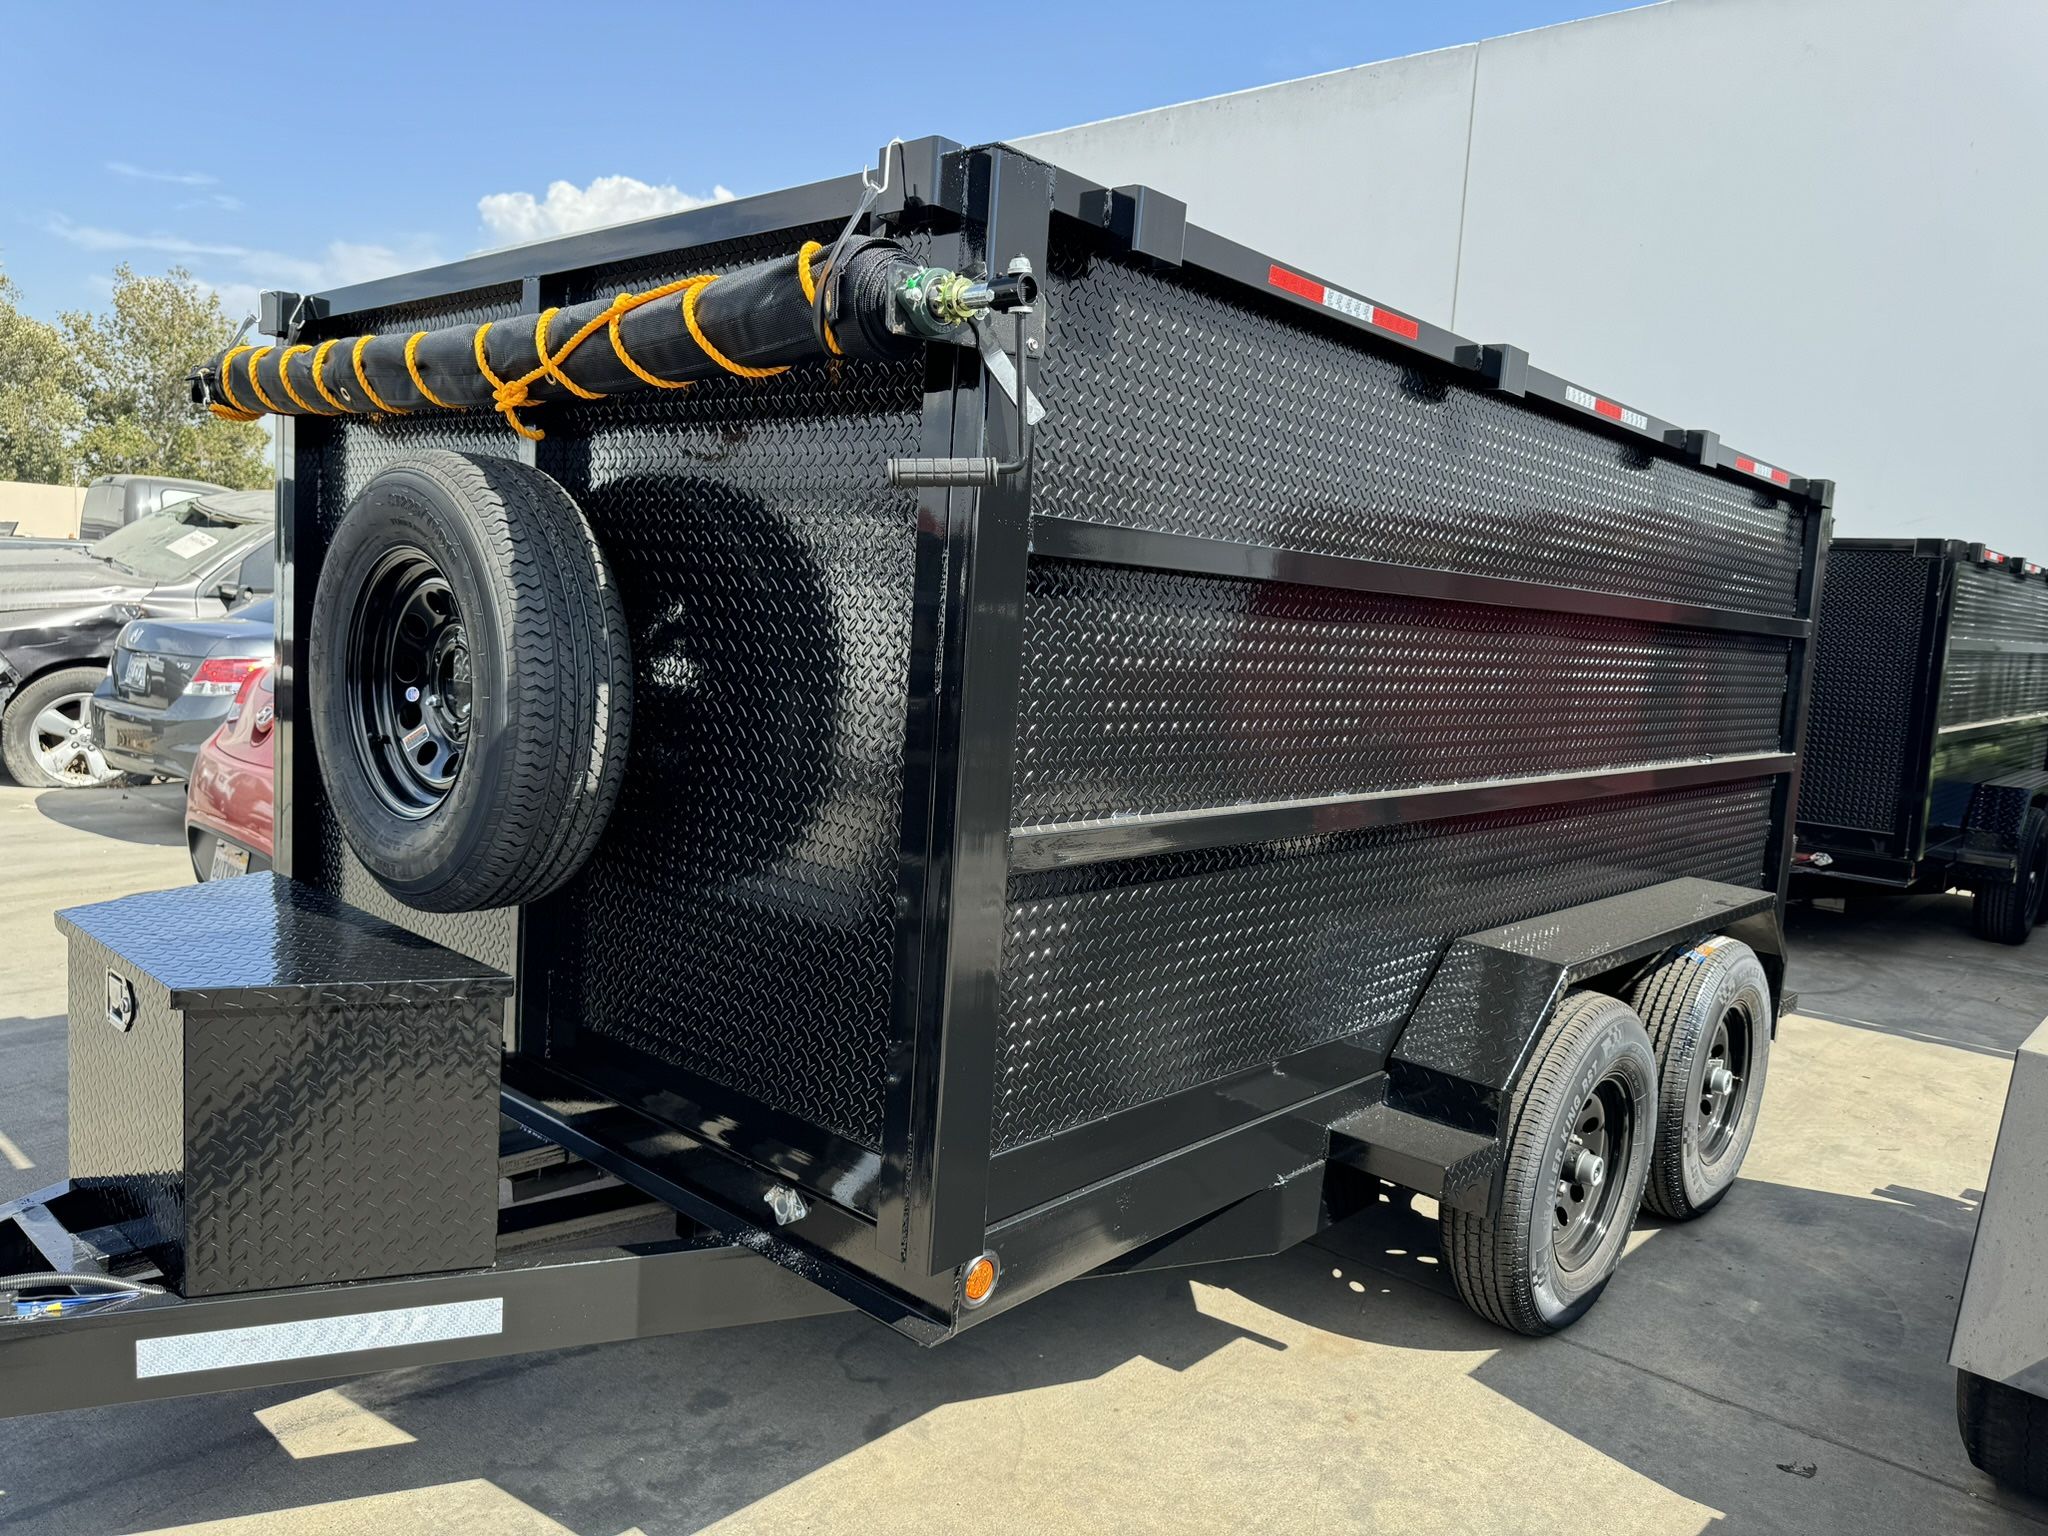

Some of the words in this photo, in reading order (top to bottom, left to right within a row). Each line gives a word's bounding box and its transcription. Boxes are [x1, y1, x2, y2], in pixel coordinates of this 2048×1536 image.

[176, 661, 191, 670] V6
[1560, 1095, 1581, 1144] KING
[1581, 1059, 1599, 1094] RST
